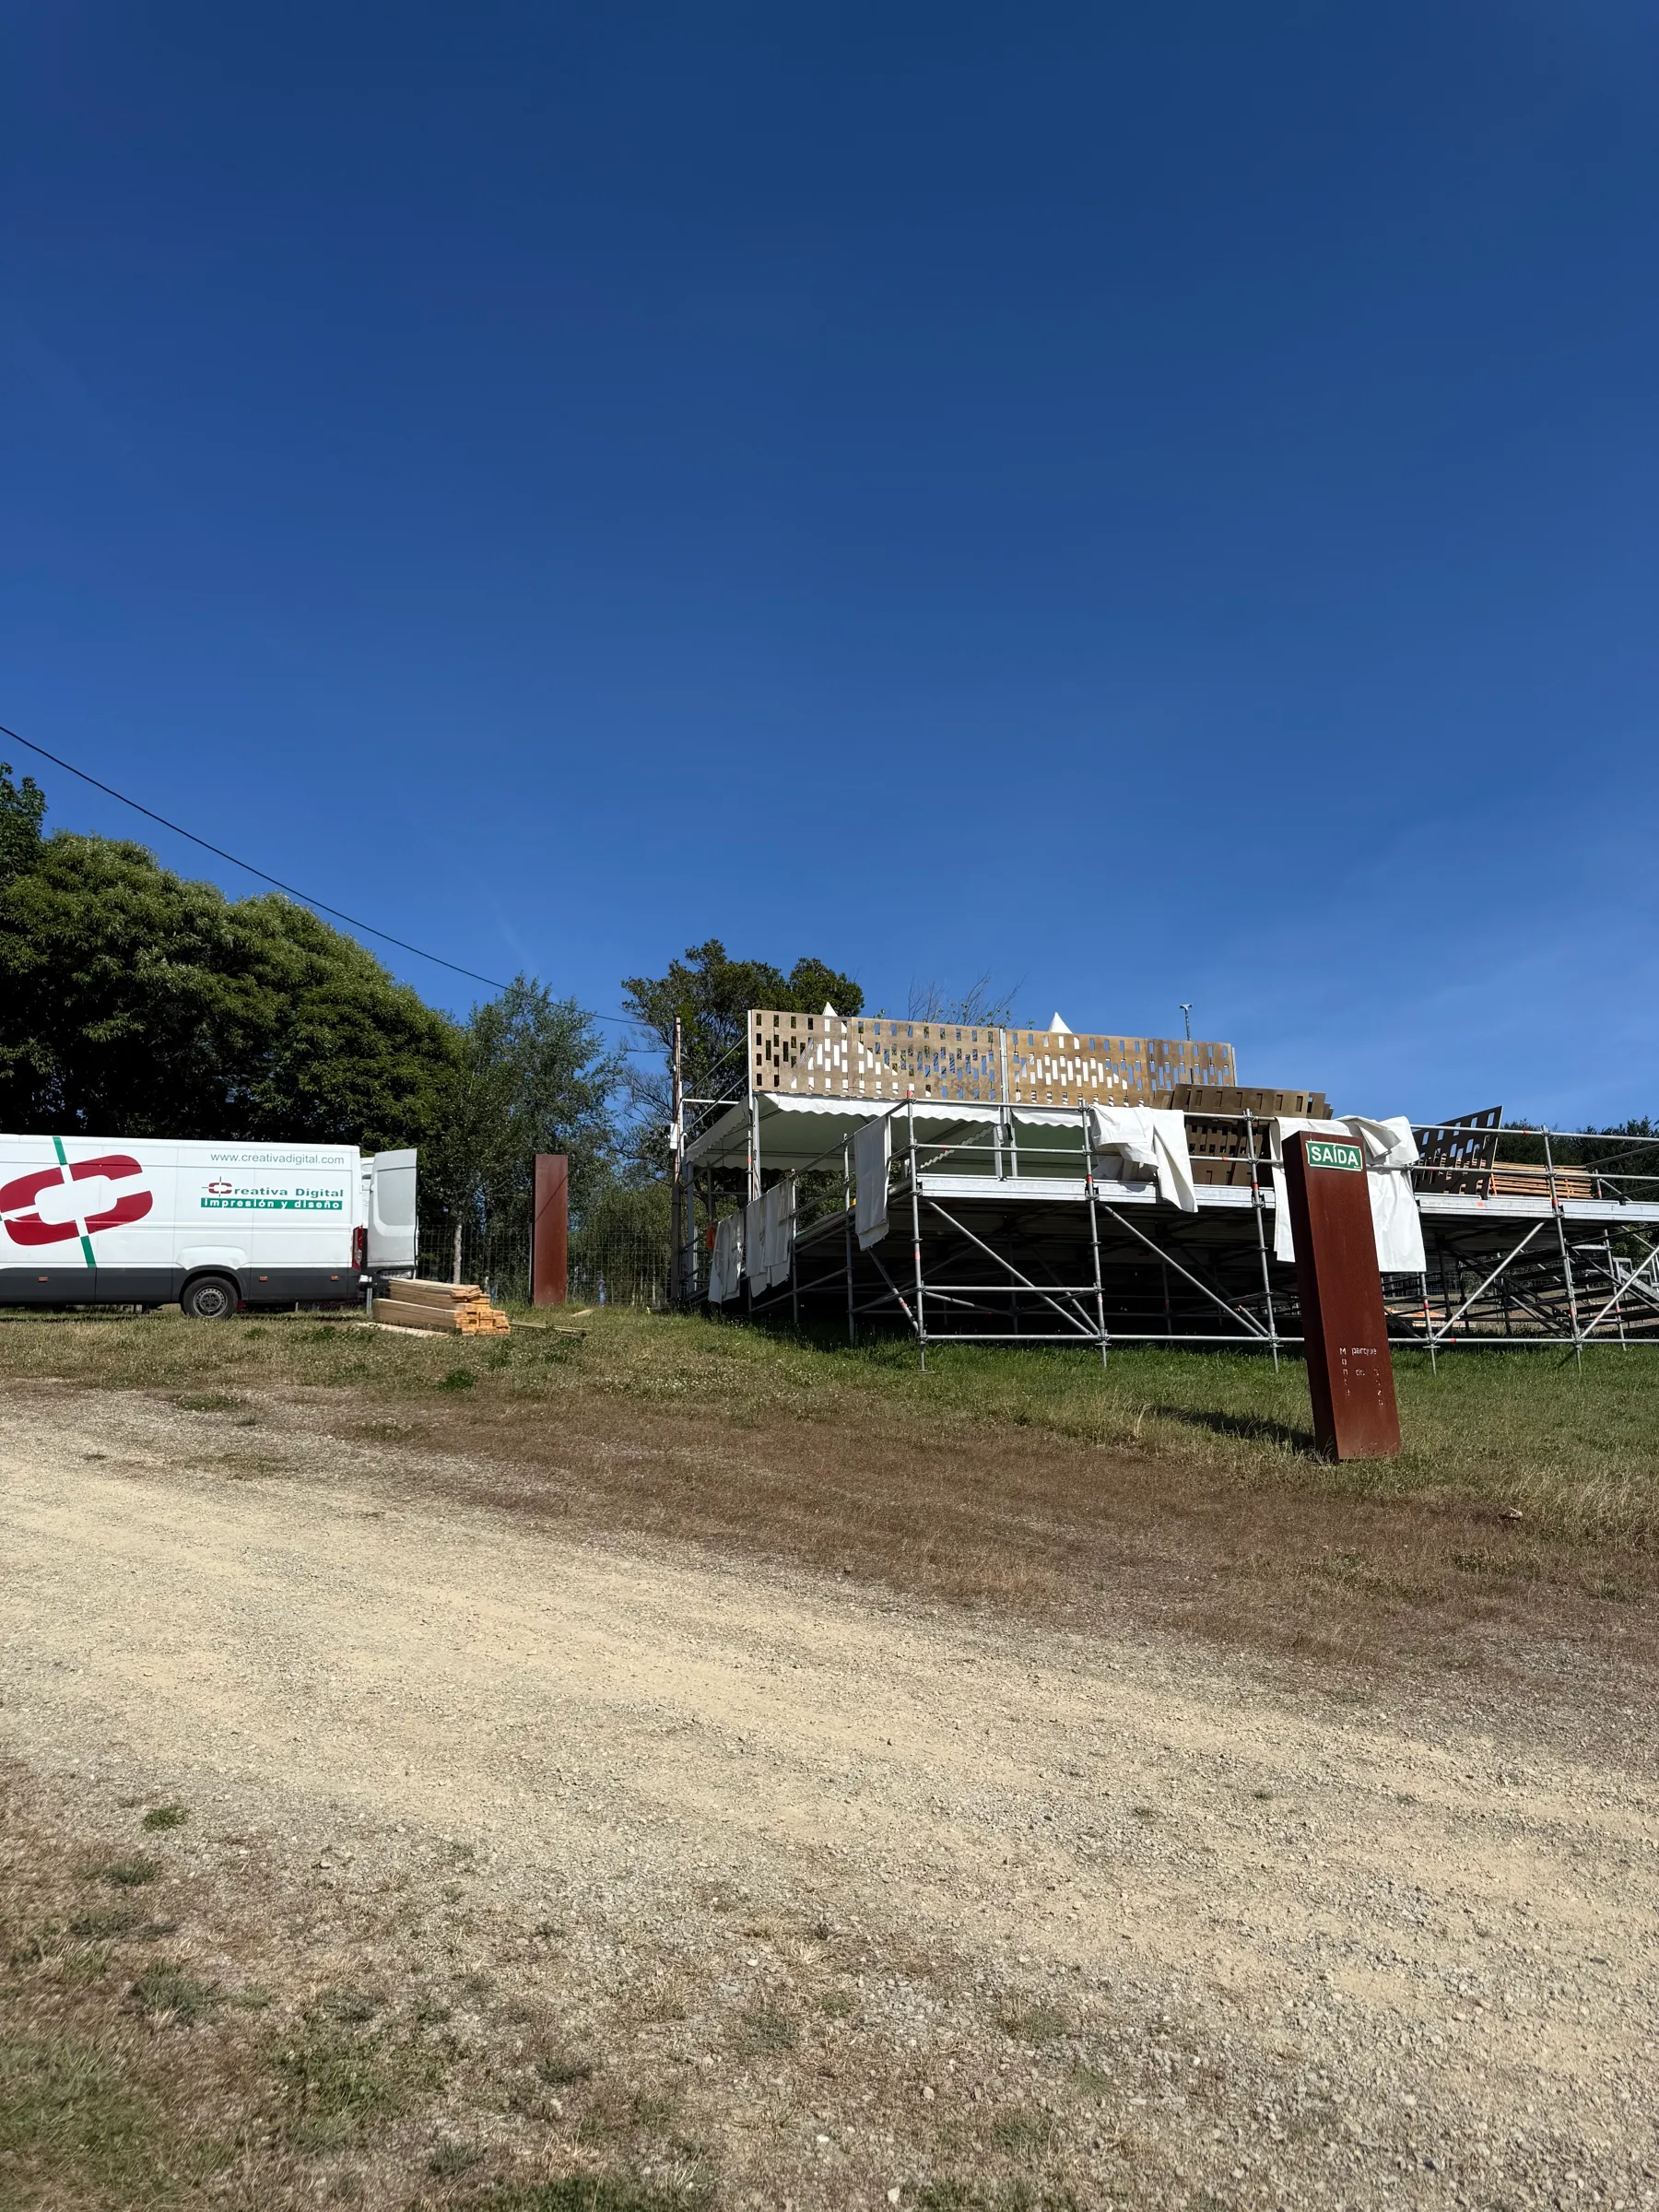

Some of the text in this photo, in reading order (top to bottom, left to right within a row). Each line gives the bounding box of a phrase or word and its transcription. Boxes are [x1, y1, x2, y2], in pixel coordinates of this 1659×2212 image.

[210, 1152, 345, 1165] www.creativadigital.com
[1311, 1146, 1359, 1166] SAÍDA
[295, 1188, 344, 1199] Digital
[280, 1200, 288, 1209] y
[294, 1199, 340, 1209] diseño
[1351, 1347, 1377, 1356] parque
